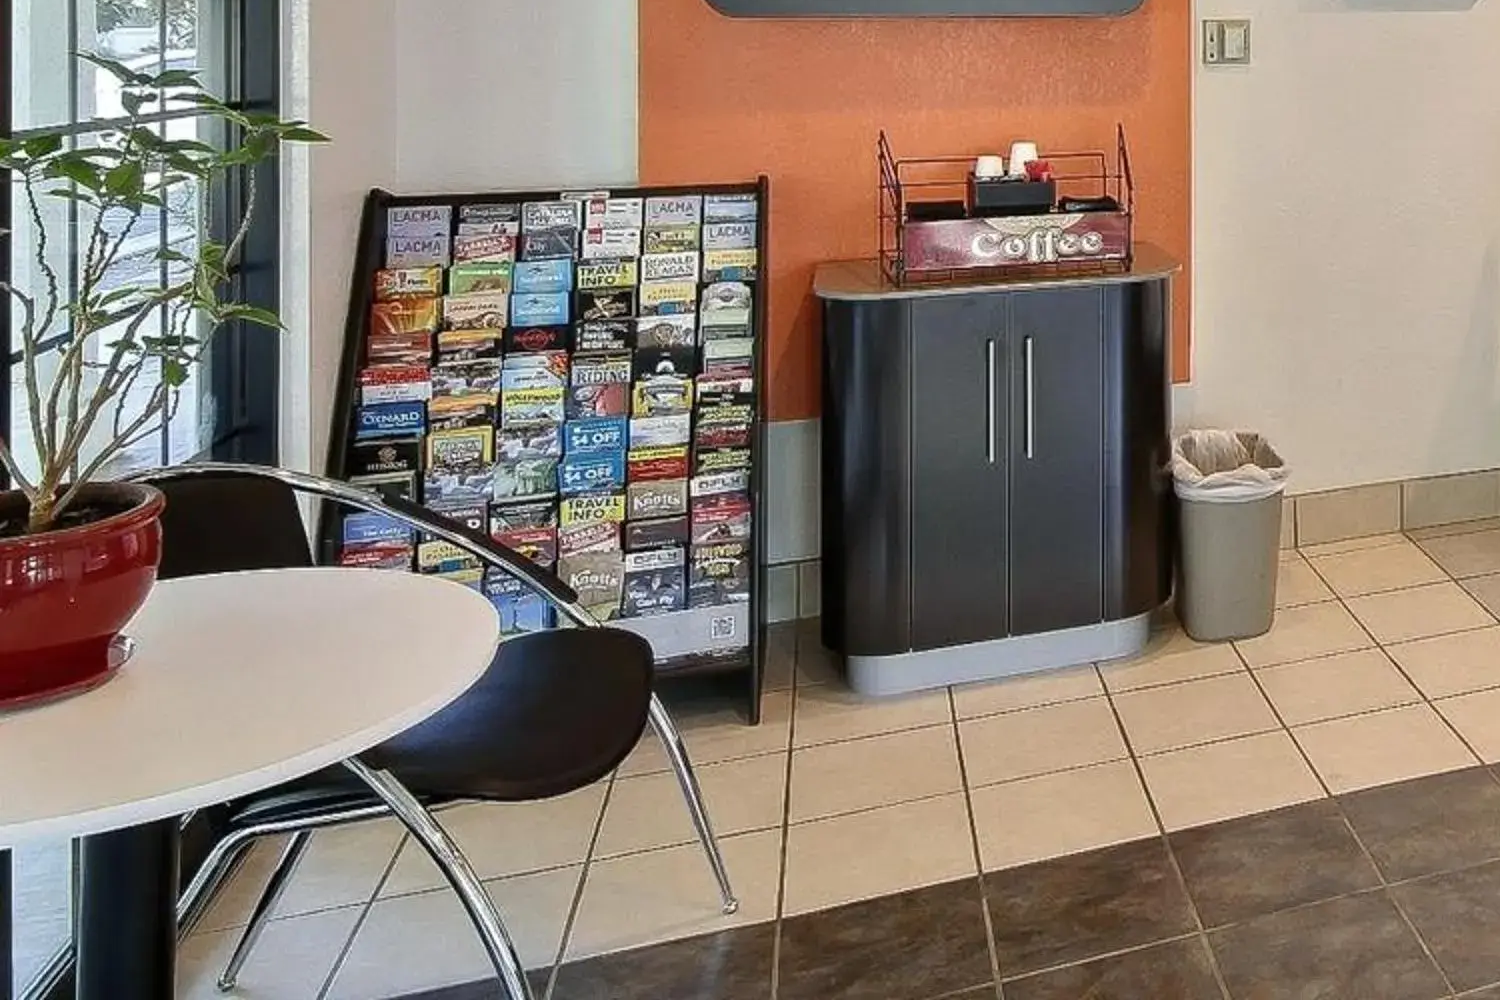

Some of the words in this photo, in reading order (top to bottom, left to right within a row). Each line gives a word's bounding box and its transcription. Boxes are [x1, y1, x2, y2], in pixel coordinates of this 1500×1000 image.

[653, 202, 694, 214] LACMA
[392, 210, 441, 223] LACMA
[709, 227, 751, 238] LACMA
[394, 241, 441, 253] LACMA
[971, 226, 1104, 263] Coffee
[580, 264, 628, 276] TRAVEL
[581, 276, 617, 286] INFO
[576, 369, 629, 384] RIDING
[592, 431, 621, 443] OFF
[584, 466, 613, 479] OFF
[569, 497, 619, 509] TRAVEL
[568, 509, 605, 521] INFO
